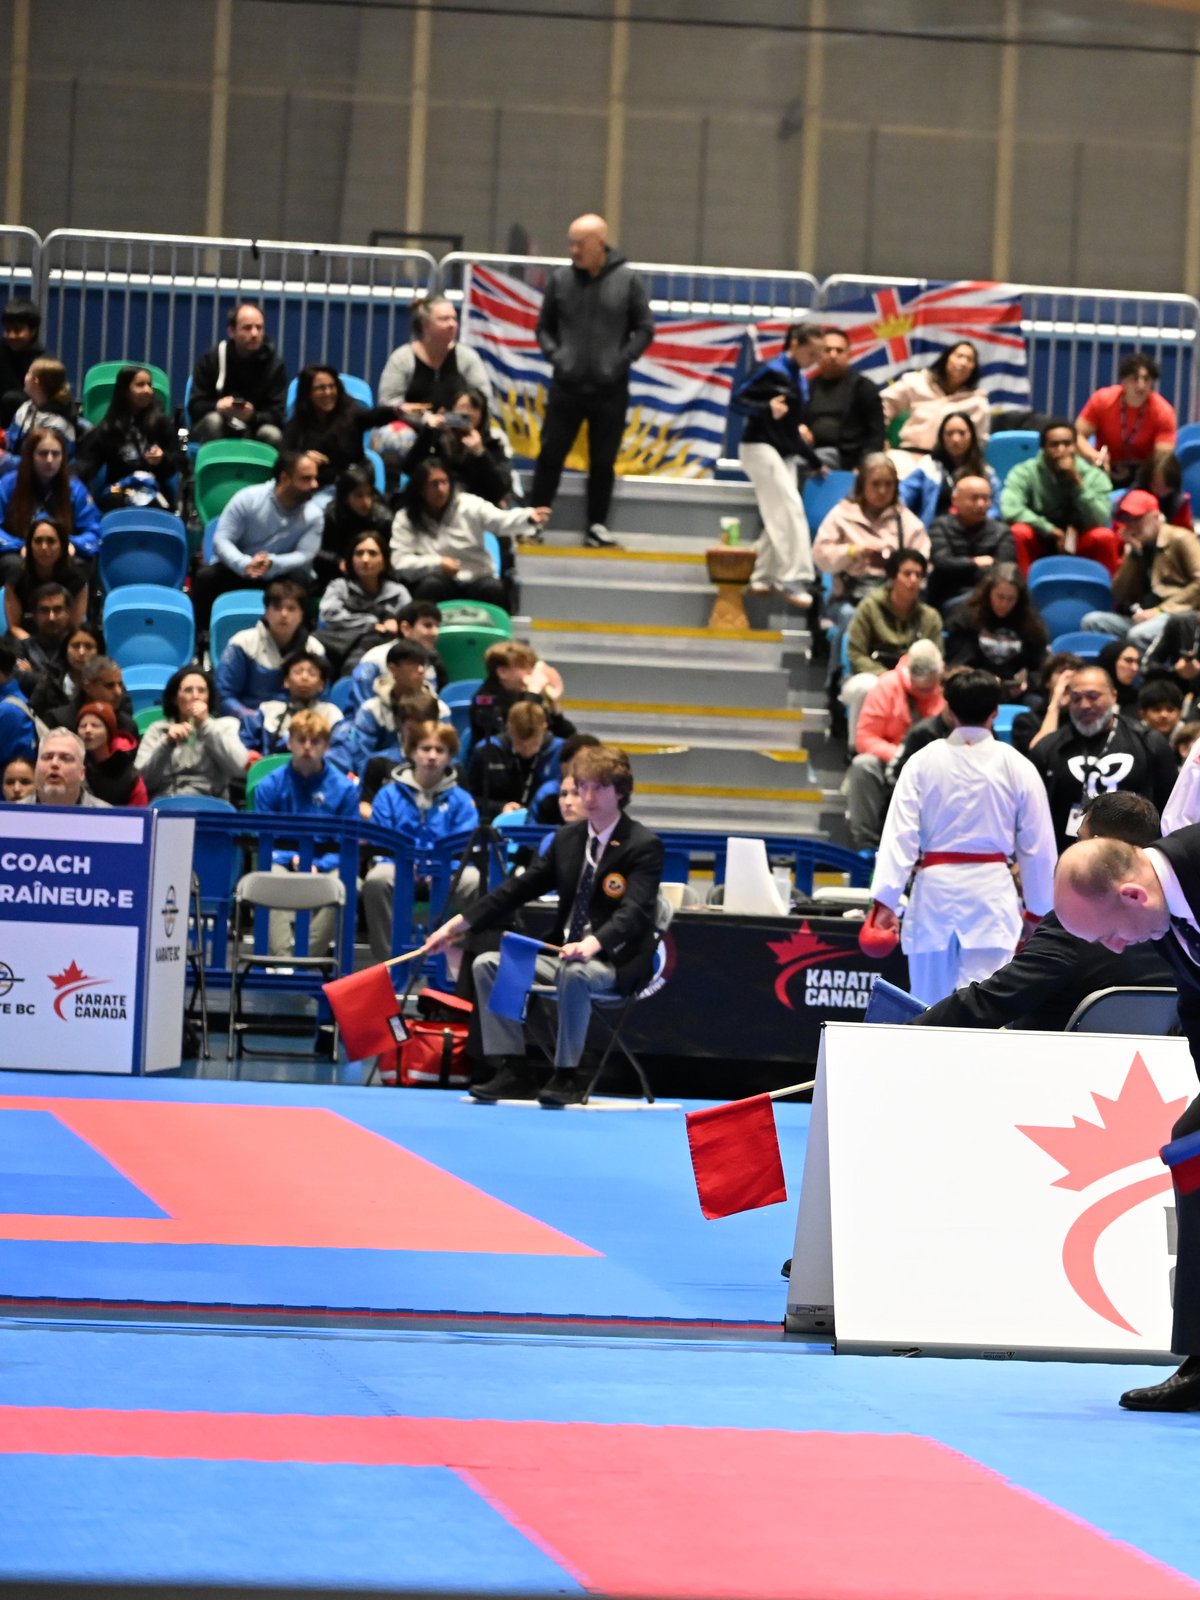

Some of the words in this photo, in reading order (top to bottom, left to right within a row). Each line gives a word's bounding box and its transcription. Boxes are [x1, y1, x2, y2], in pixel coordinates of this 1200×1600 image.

[1, 852, 91, 875] COACH
[75, 994, 127, 1006] KARATE
[805, 988, 870, 1009] CANAD
[15, 1003, 36, 1015] BC
[74, 1006, 127, 1020] CANADA
